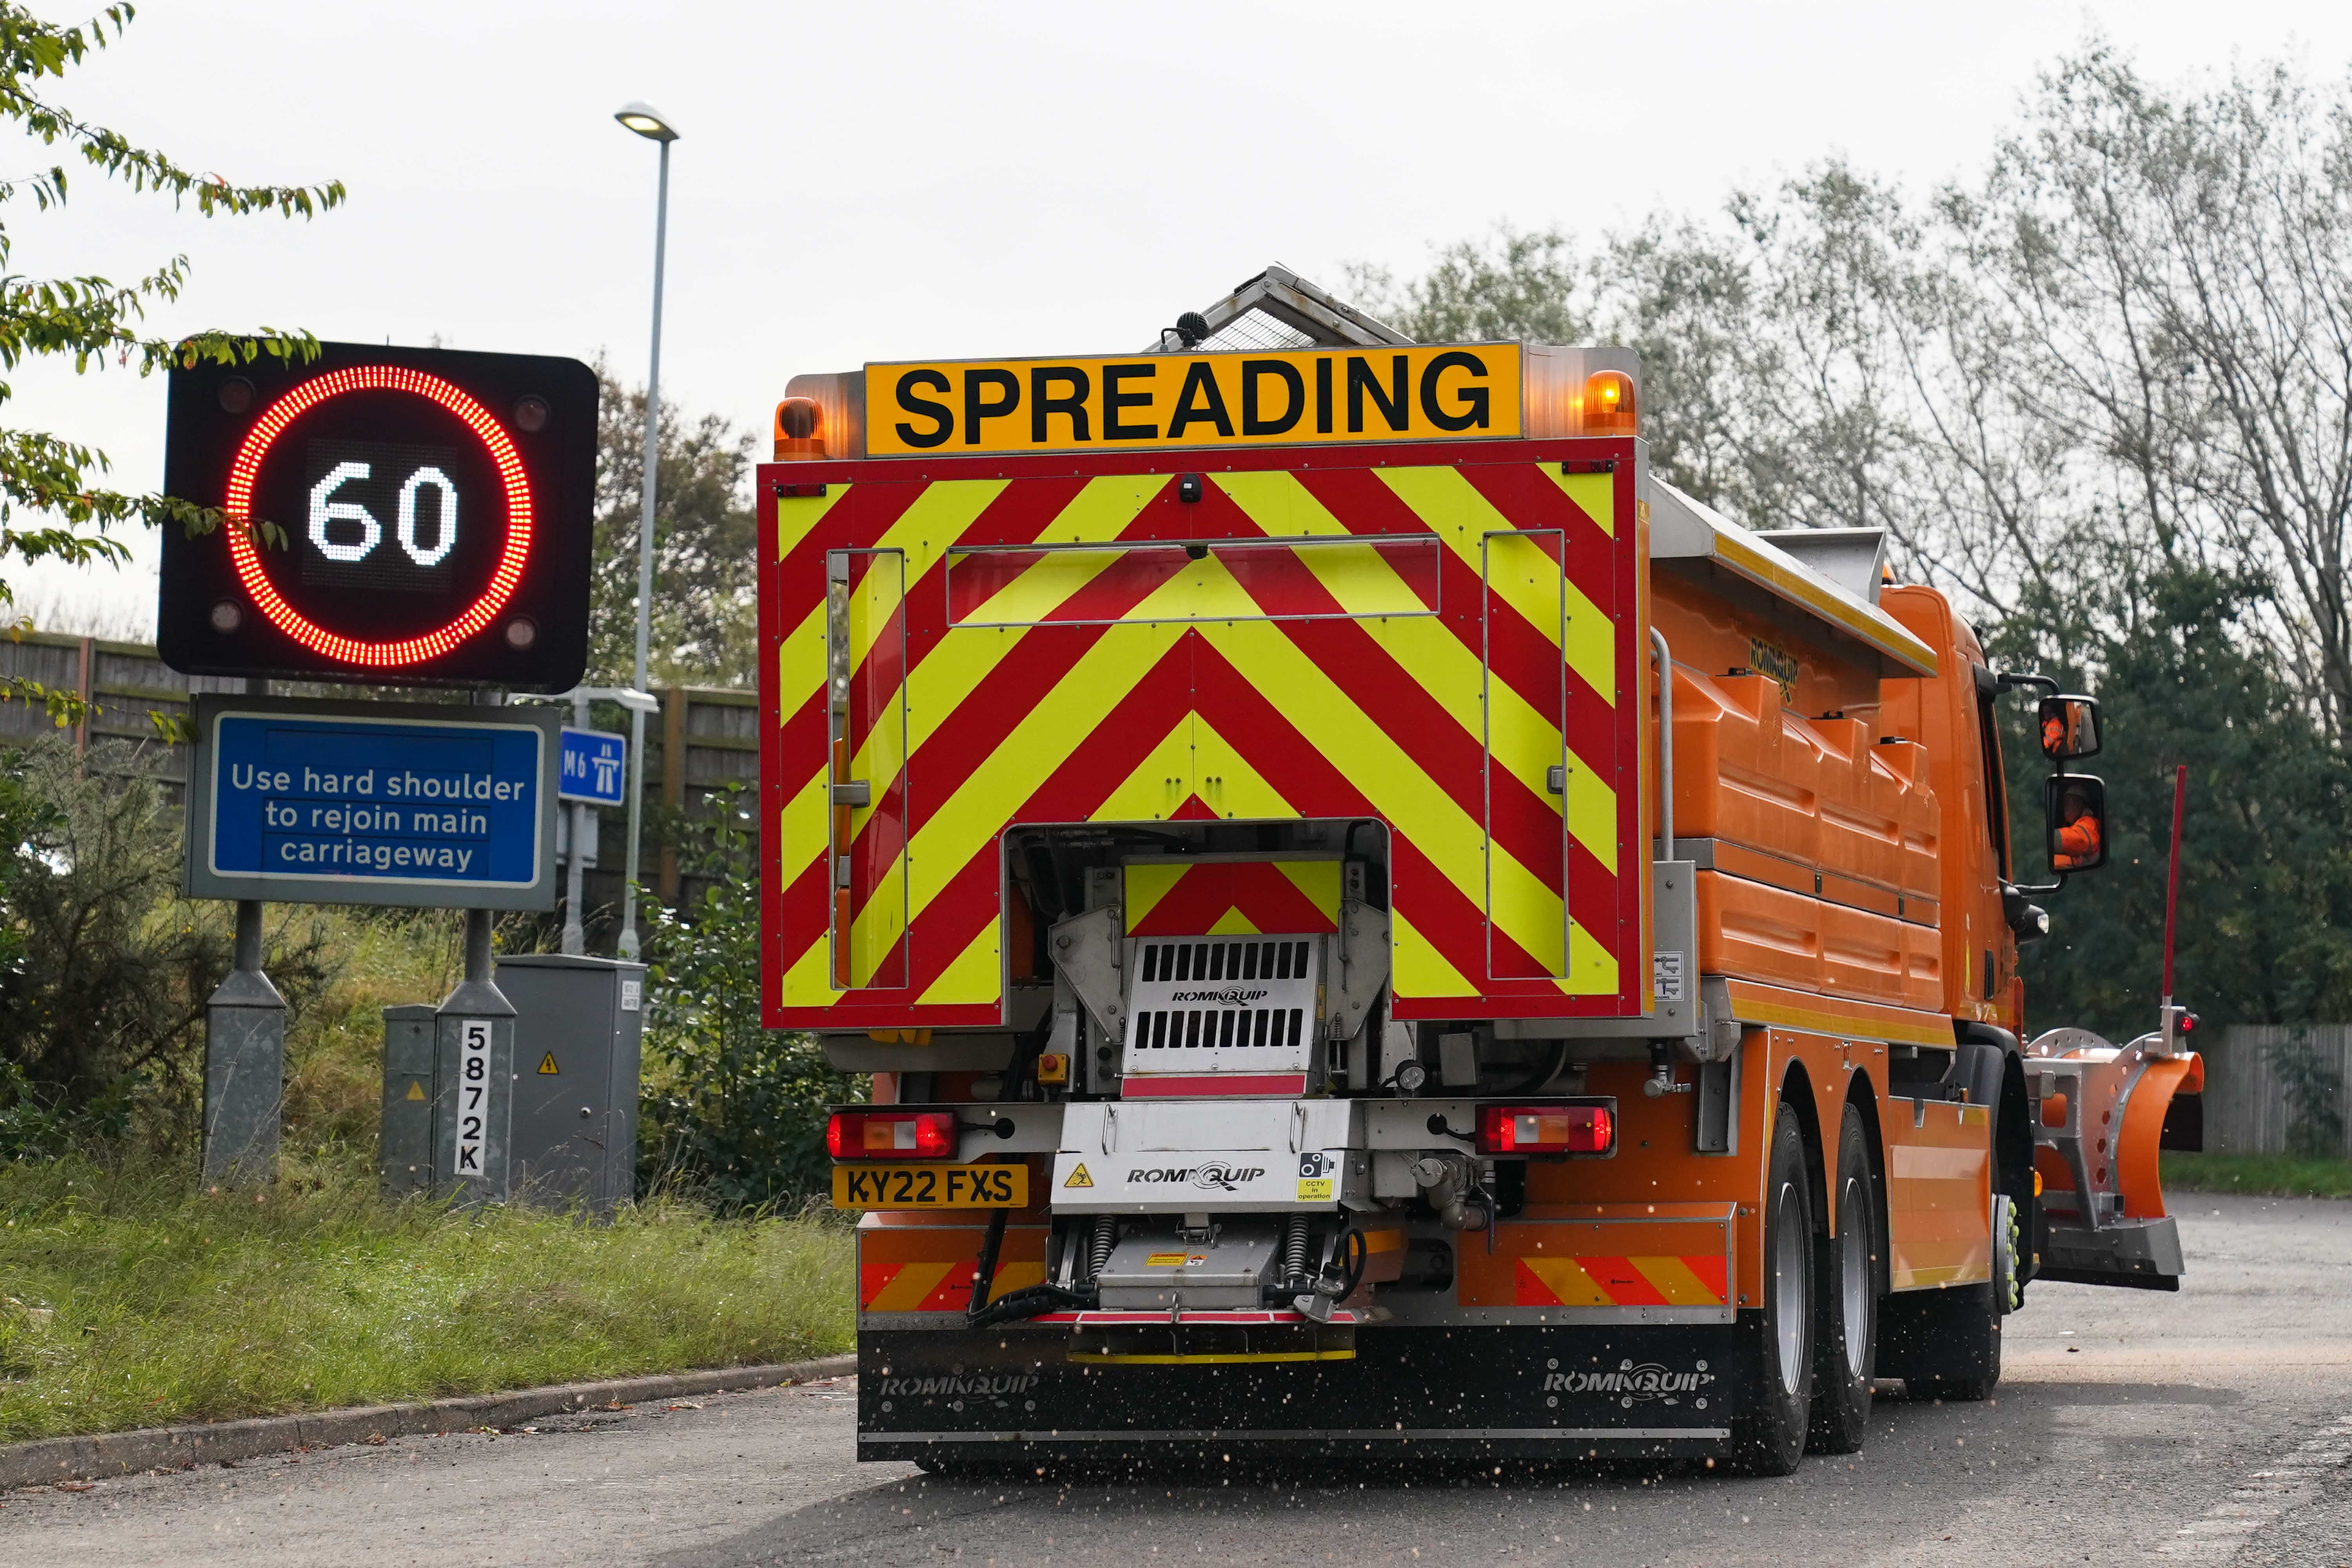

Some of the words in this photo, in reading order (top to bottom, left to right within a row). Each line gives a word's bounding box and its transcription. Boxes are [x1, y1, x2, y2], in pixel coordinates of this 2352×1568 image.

[895, 351, 1489, 448] SPREADING
[309, 462, 457, 566] 60
[1751, 637, 1798, 702] ROMAQUIP
[564, 749, 586, 779] M6
[232, 763, 290, 791] Use
[304, 766, 374, 795] hard
[387, 771, 524, 801] shoulder
[265, 800, 297, 827] to
[312, 804, 400, 834] rejoin
[414, 808, 486, 834] main
[281, 838, 472, 873] carriageway
[1172, 990, 1268, 1007] ROMAQUIP
[460, 1027, 485, 1169] 5872K
[848, 1171, 936, 1202] KY22
[947, 1171, 1012, 1202] FXS
[1127, 1167, 1265, 1192] ROMAQUIP
[880, 1375, 1039, 1408] ROMAQUIP
[1543, 1372, 1711, 1406] ROMAQUIP
